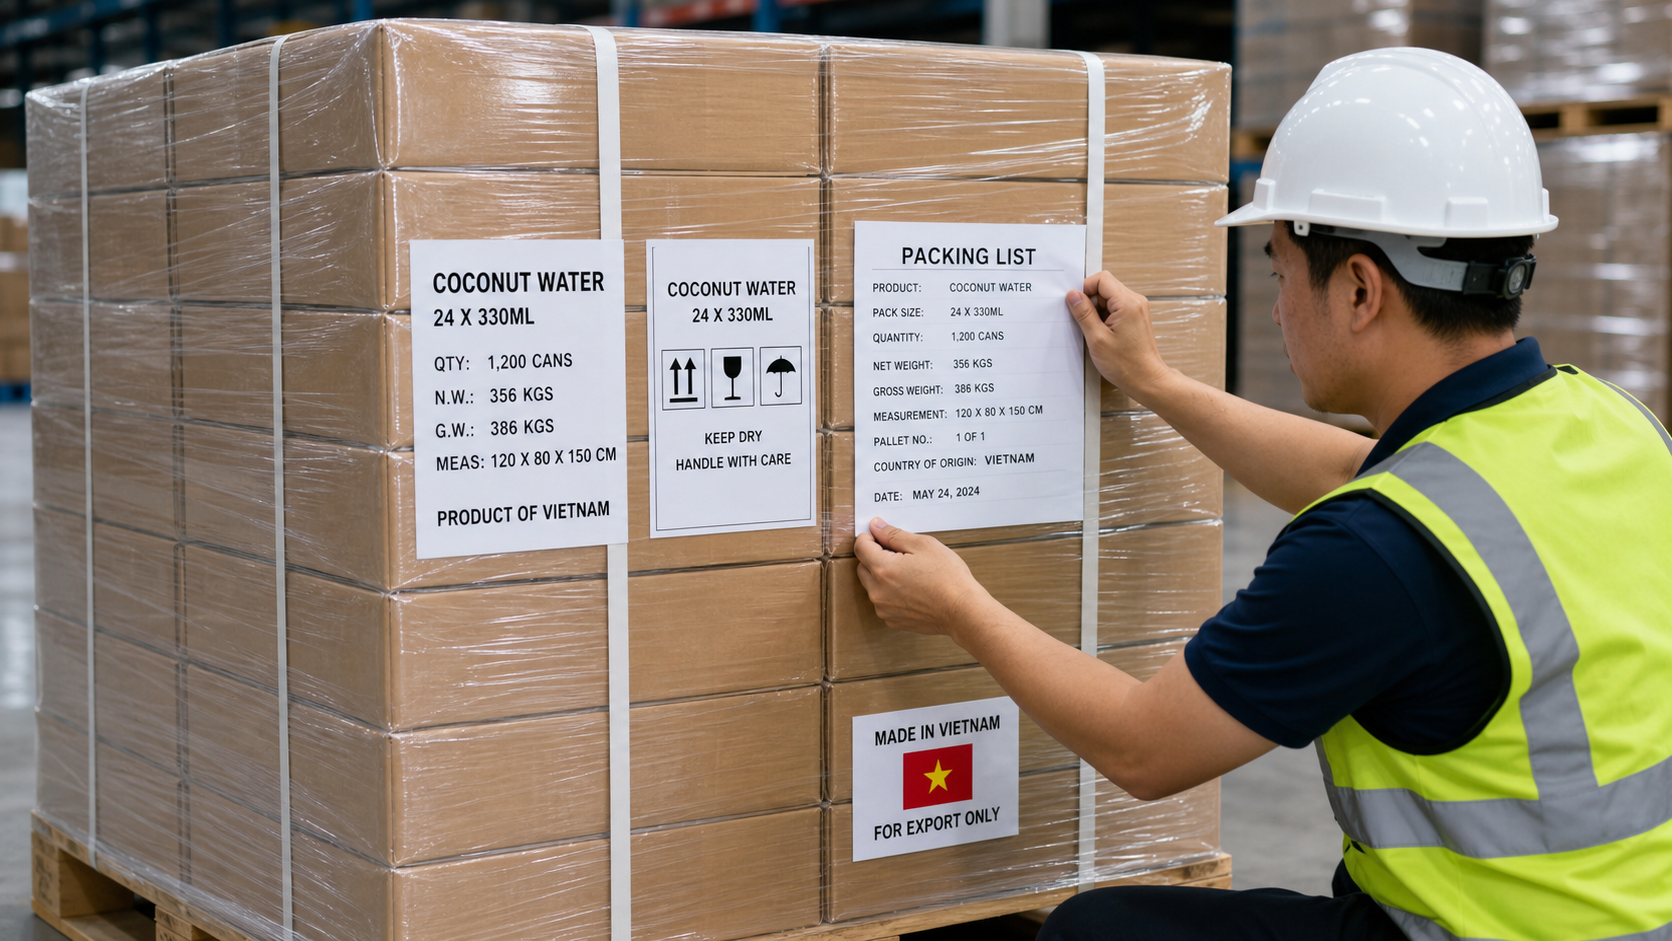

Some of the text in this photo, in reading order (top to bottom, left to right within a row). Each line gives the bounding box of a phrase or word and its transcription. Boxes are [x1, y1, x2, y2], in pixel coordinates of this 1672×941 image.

[903, 247, 1036, 265] PACKING LIST
[433, 272, 604, 293] COCONUT WATER
[668, 281, 795, 297] COCONUT WATER
[873, 283, 1031, 292] PRODUCT: COCONUT WATER
[434, 307, 534, 327] 24 X 330ML
[693, 307, 773, 323] 24 X 330ML
[873, 307, 1003, 317] PACK SIZE: 24 X 330ML
[873, 331, 1004, 343] QUANTITY: 1,200 CANS
[435, 353, 572, 372] QTY: 1,200 CANS
[874, 359, 992, 370] NET WEIGHT: 356 KGS
[435, 386, 553, 405] N.W.: 356 KGS
[873, 383, 994, 396] GROSS WEIGHT: 386 KGS
[874, 405, 1042, 421] MEASUREMENT: 120 X 80 X 150 CM
[436, 419, 554, 438] G.W.: 386 KGS
[705, 430, 762, 444] KEEP DRY
[874, 431, 985, 446] PALLET NO.: 1 OF 1
[437, 447, 616, 471] MEAS: 120 X 80 X 150 CM
[676, 453, 791, 471] HANDLE WITH CARE
[874, 453, 1034, 472] COUNTRY OF ORIGIN: VIETNAM
[875, 486, 980, 502] DATE: MAY 24, 2024
[438, 501, 609, 526] PRODUCT OF VIETNAM
[875, 715, 1000, 746] MADE IN VIETNAM
[875, 806, 1000, 841] FOR EXPORT ONLY
